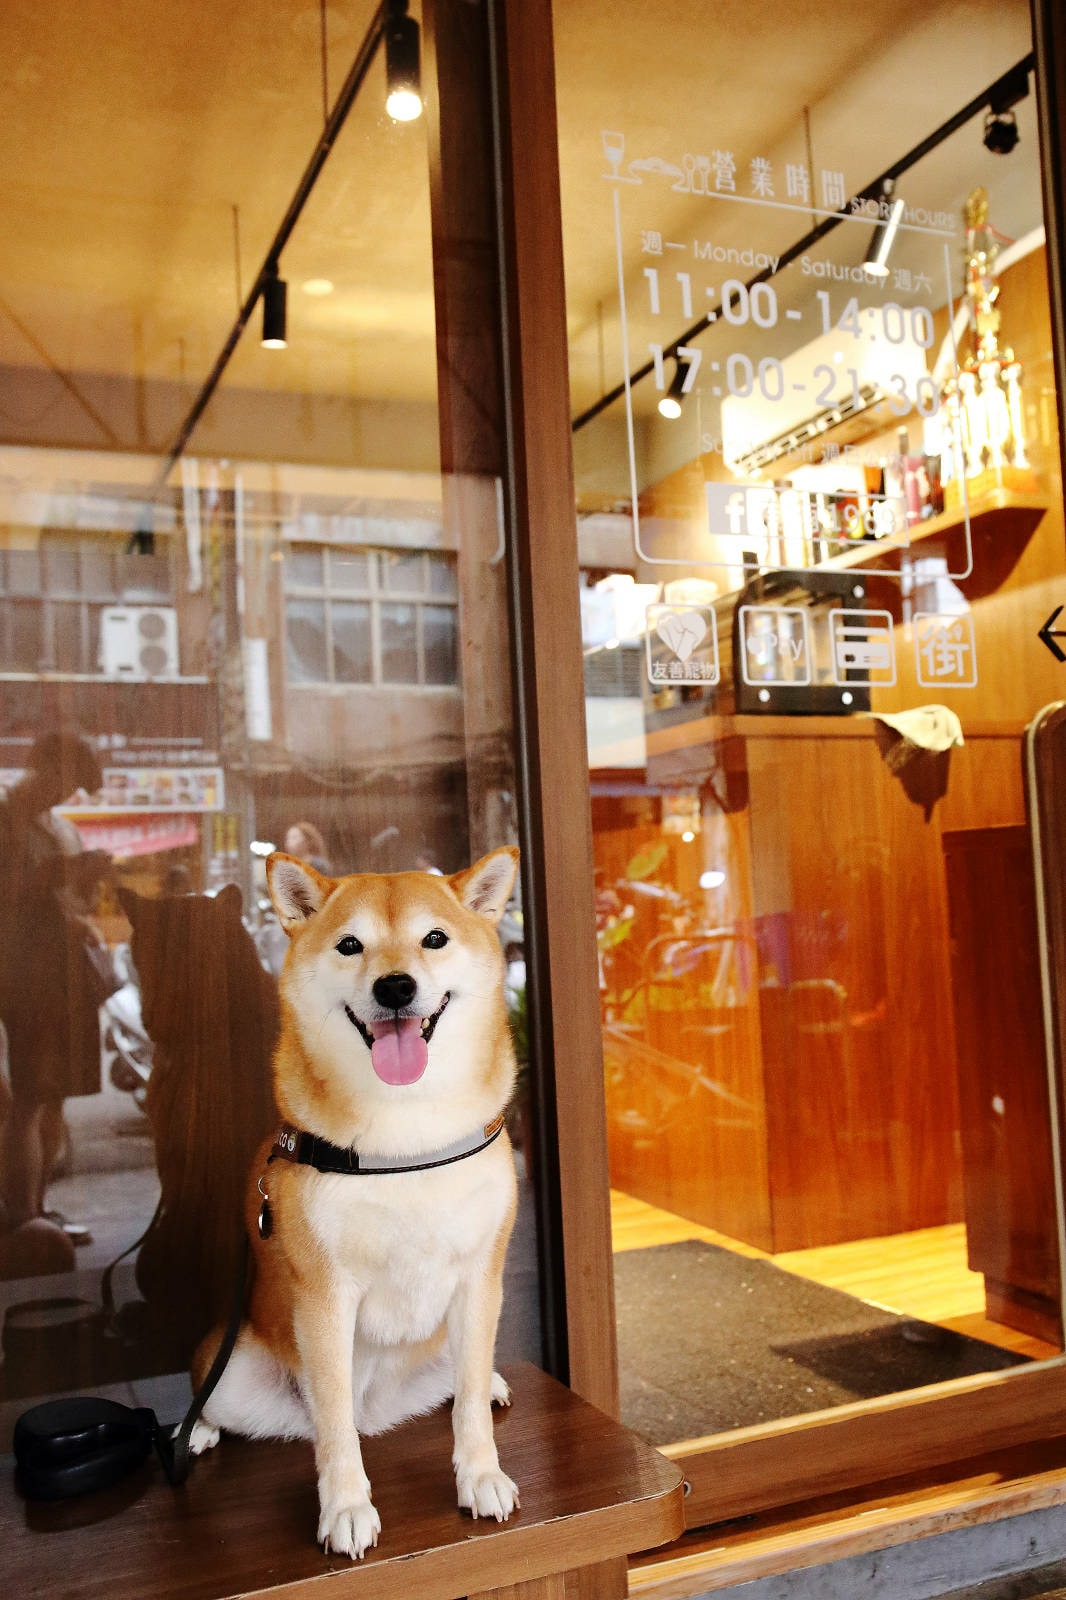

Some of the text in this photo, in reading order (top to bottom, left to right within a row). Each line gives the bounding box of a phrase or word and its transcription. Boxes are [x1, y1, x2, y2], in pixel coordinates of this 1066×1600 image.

[711, 150, 847, 210] 營業時間
[904, 207, 957, 230] HOURS
[642, 230, 687, 255] 週一
[693, 239, 780, 275] Monday
[893, 267, 933, 295] 週六
[921, 624, 970, 677] 街
